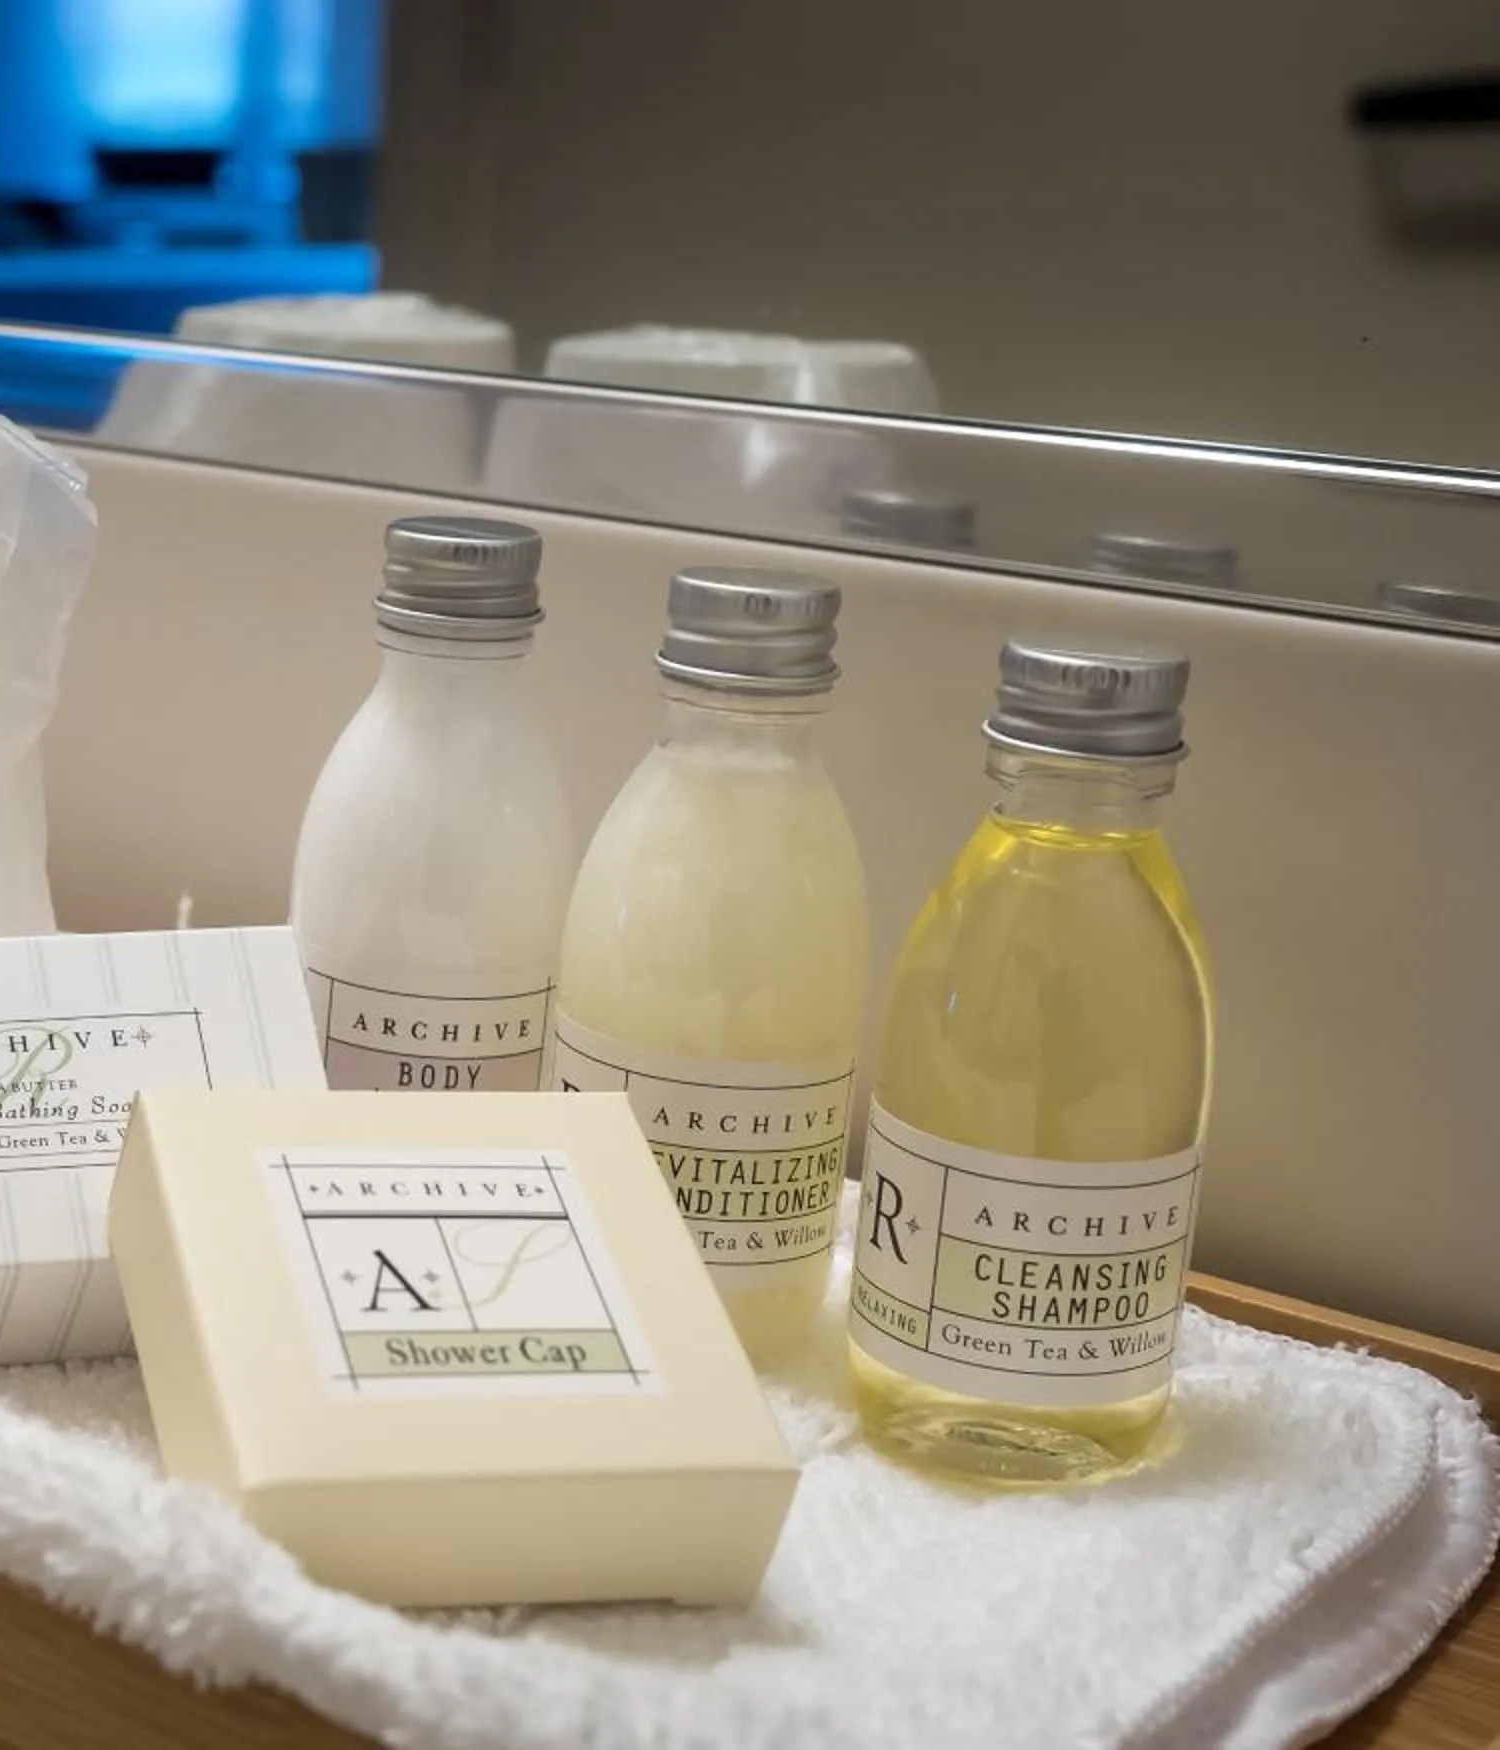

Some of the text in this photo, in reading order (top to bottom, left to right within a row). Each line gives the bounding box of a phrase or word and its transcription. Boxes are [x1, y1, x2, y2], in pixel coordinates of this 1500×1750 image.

[352, 1013, 530, 1041] ARCHIVE
[398, 1062, 481, 1089] BODY
[91, 1096, 133, 1114] Soa
[653, 1106, 836, 1133] ARCHIVE
[54, 1131, 88, 1146] Tea
[94, 1128, 110, 1143] &
[652, 1148, 837, 1184] VITALIZING
[327, 1181, 533, 1198] ARCHIVE
[675, 1181, 830, 1216] NDITIONER
[870, 1171, 909, 1265] R
[974, 1205, 1179, 1237] ARCHIVE
[698, 1231, 737, 1250] Tea
[746, 1231, 764, 1250] &
[361, 1249, 442, 1312] A
[974, 1253, 1167, 1292] CLEANSING
[858, 1285, 917, 1335] RELAXING
[992, 1291, 1149, 1325] SHAMPOO
[385, 1336, 587, 1370] Shower Cap
[941, 1323, 1166, 1361] Green Tea & Willow
